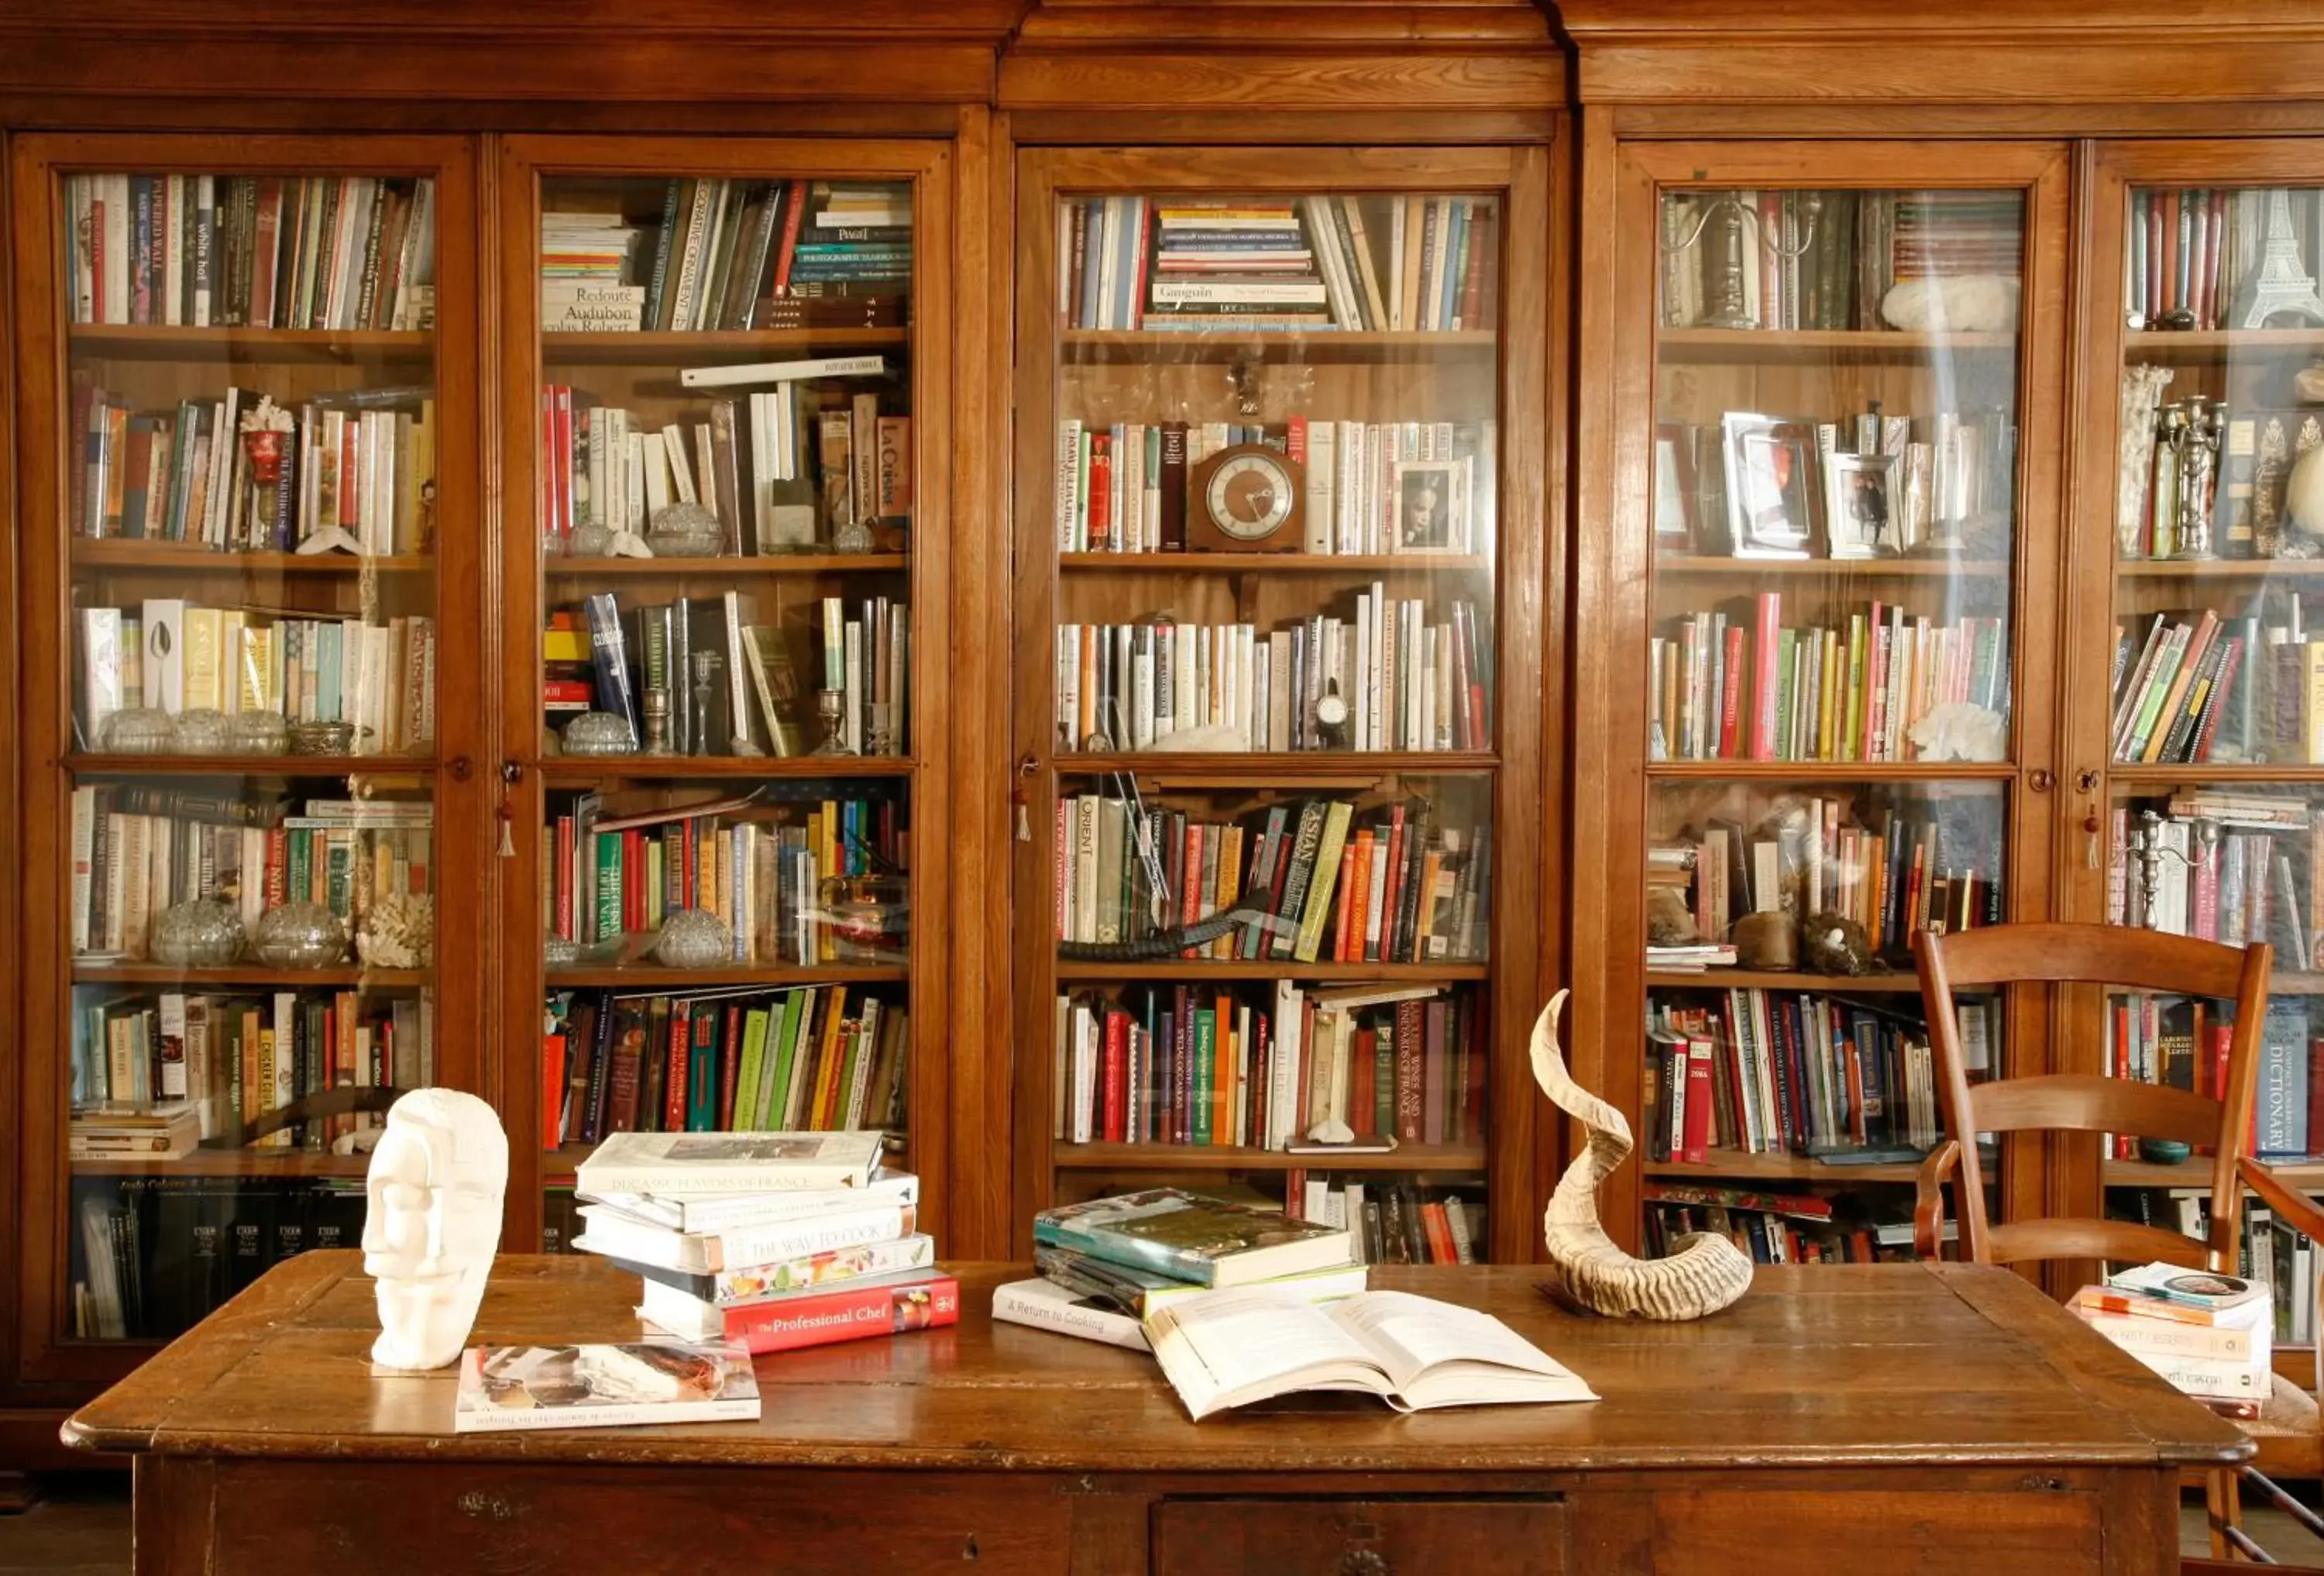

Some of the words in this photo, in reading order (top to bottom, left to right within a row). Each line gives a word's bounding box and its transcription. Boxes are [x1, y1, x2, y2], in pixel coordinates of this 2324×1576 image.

[689, 184, 708, 246] ECORATIVE
[152, 239, 162, 273] WALL
[197, 223, 209, 256] white
[196, 260, 208, 281] hot
[679, 246, 698, 308] ORNAMENT
[565, 305, 633, 321] Audubon
[1080, 802, 1094, 858] ORIENT
[1399, 1001, 1411, 1060] VINEYARDS
[1410, 1055, 1421, 1089] WINES
[1399, 1074, 1411, 1117] FRANCE
[1410, 1093, 1420, 1117] AND
[2270, 1046, 2284, 1150] DICTIONARY
[782, 1233, 812, 1253] WAY
[773, 1308, 852, 1333] Professional
[855, 1304, 887, 1323] Chef
[1016, 1302, 1050, 1320] Return
[1053, 1309, 1062, 1322] to
[1064, 1313, 1105, 1333] Cooking
